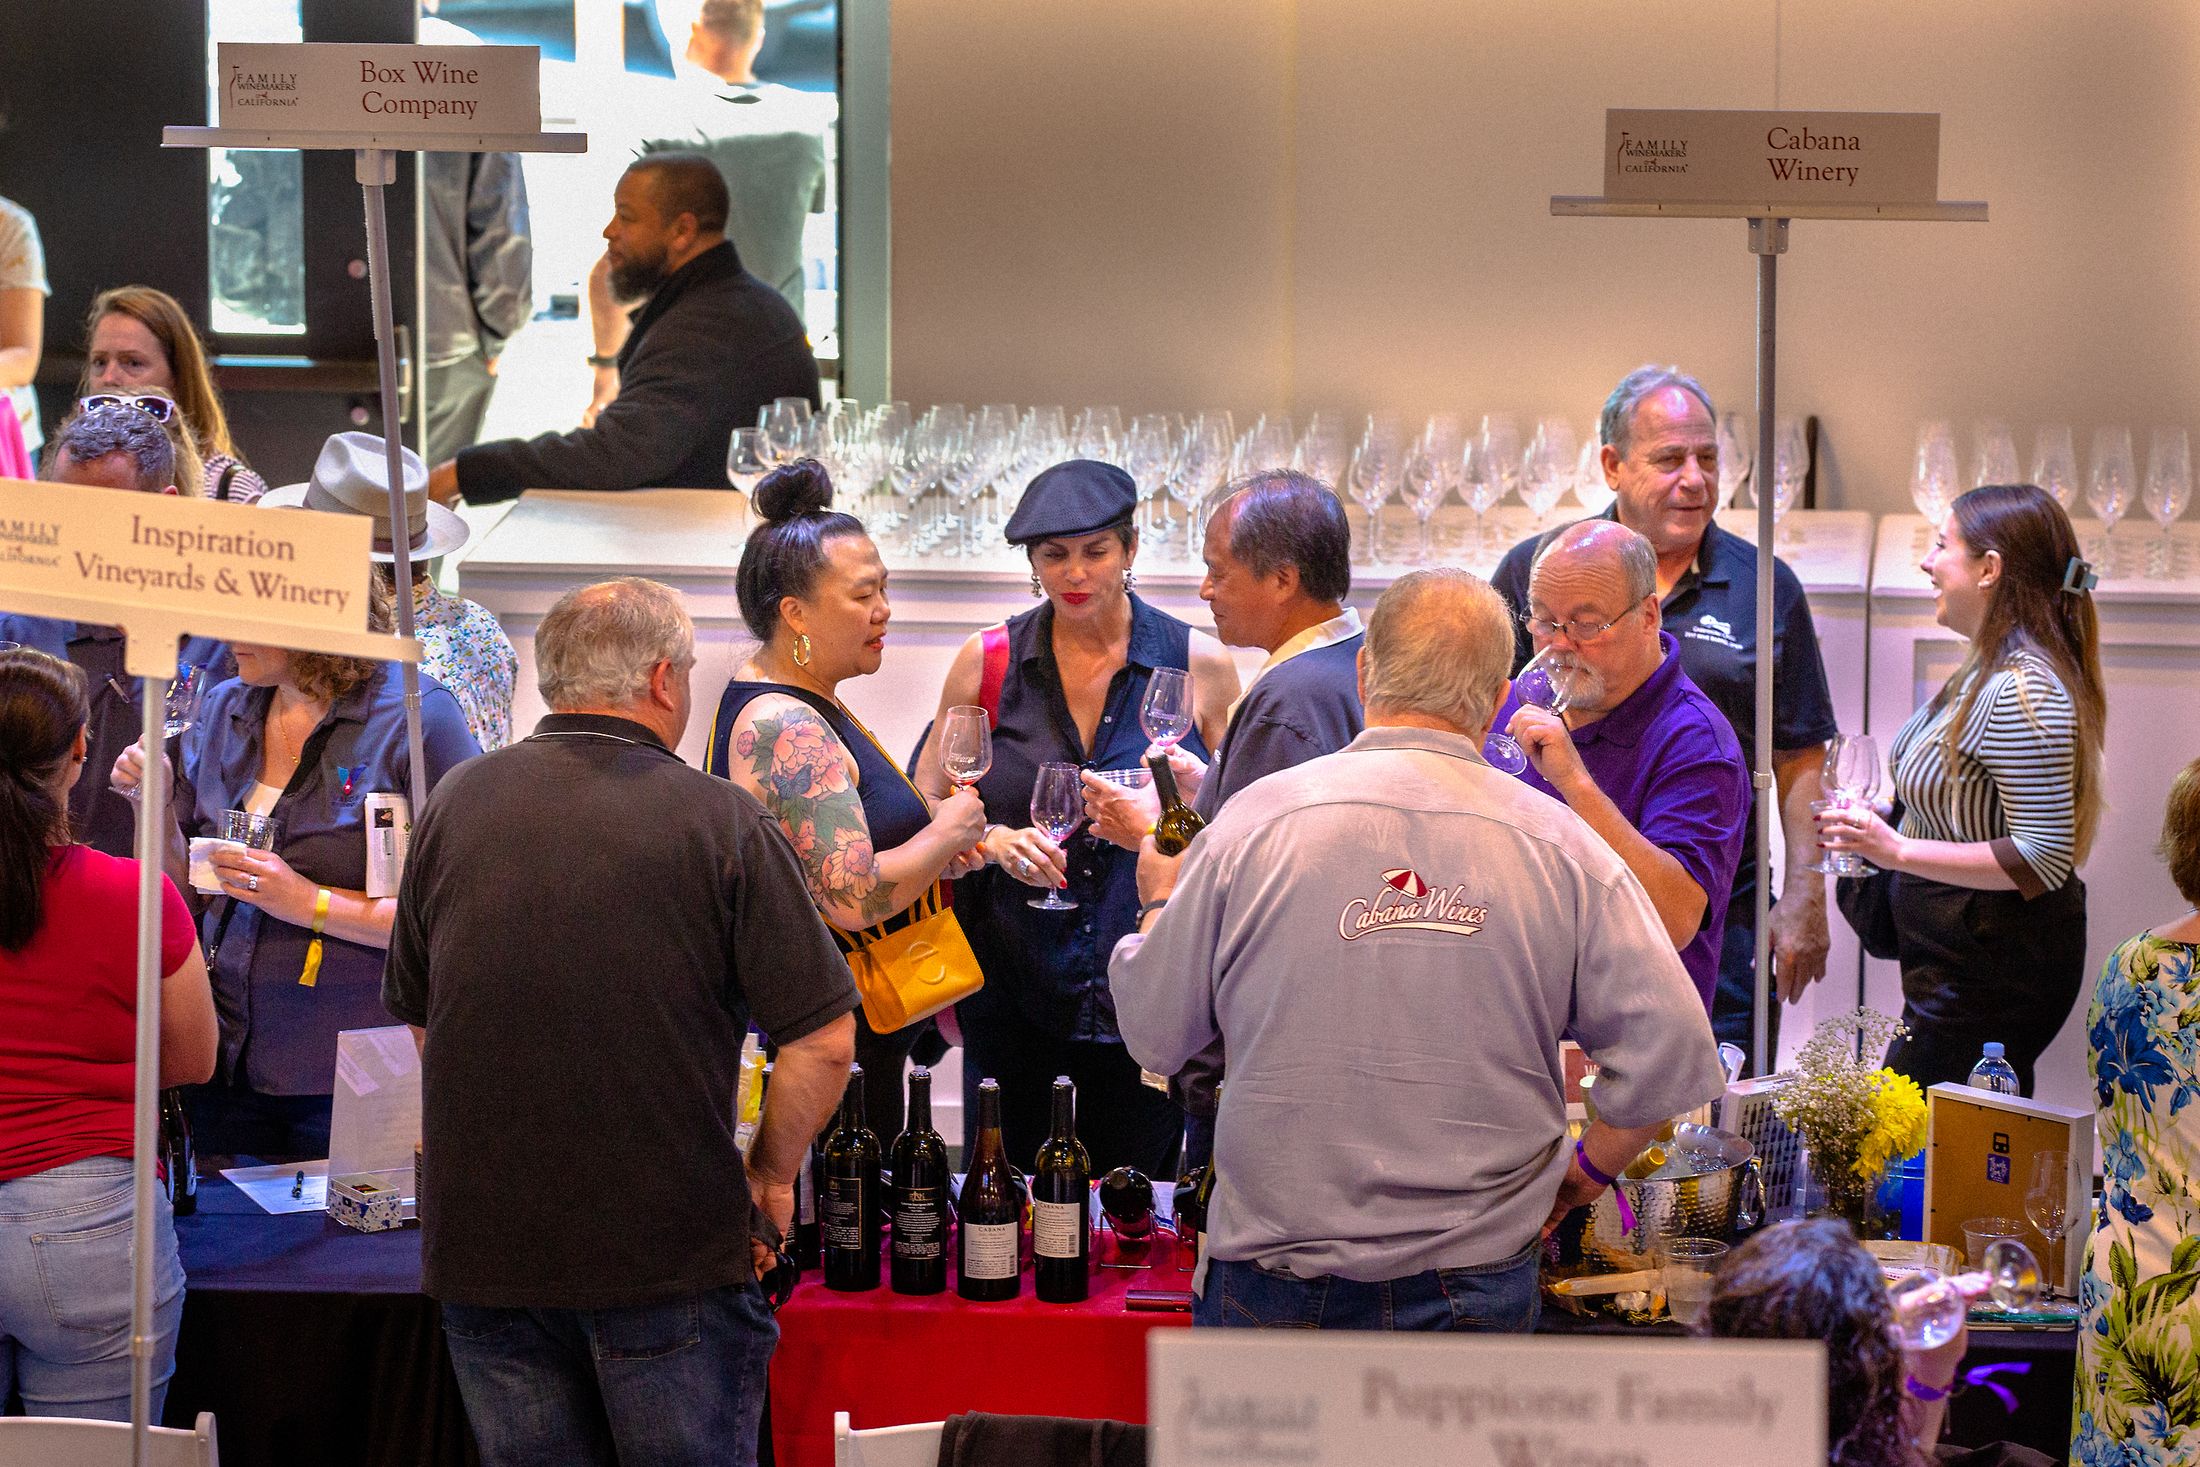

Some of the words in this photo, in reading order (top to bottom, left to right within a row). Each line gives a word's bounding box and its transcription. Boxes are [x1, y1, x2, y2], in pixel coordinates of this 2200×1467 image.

[237, 74, 297, 83] FAMILY
[360, 60, 405, 83] Box
[412, 61, 479, 84] Wine
[237, 83, 297, 91] WINEMAKERS
[238, 98, 297, 106] CALIFORNIA
[362, 91, 478, 120] Company
[1625, 140, 1688, 149] FAMILY
[1767, 127, 1861, 151] Cabana
[1625, 149, 1687, 157] WINEMAKERS
[1625, 165, 1686, 173] CALIFORNIA
[1767, 158, 1860, 187] Winery
[131, 515, 296, 562] Inspiration
[74, 551, 206, 592] Vineyards
[214, 568, 242, 596] &
[249, 570, 350, 612] Winery
[1338, 885, 1423, 941] Cabana
[1422, 883, 1489, 924] Wines
